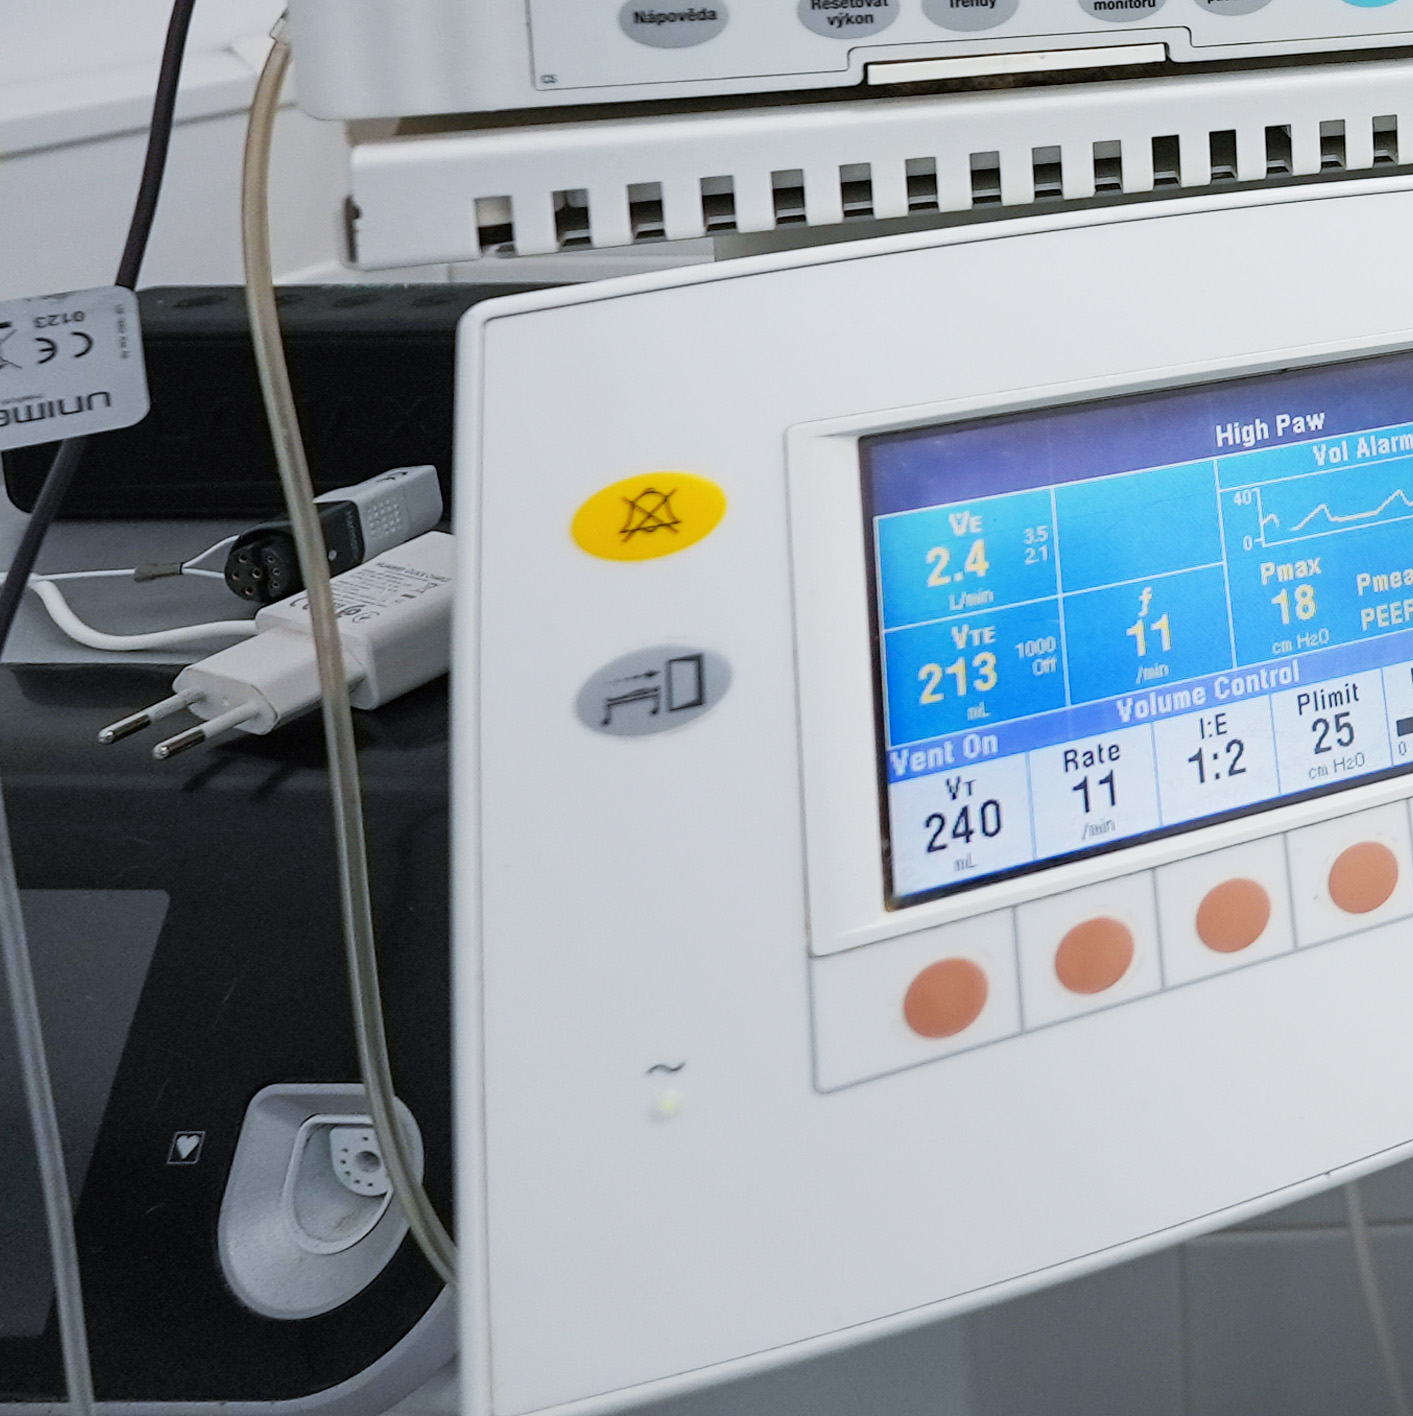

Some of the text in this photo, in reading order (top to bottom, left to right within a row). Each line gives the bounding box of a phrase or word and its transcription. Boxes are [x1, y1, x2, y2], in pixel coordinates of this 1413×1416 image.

[827, 11, 874, 27] výkon
[34, 311, 86, 328] 0123
[1215, 409, 1325, 449] High Paw
[1312, 441, 1350, 469] Vol
[1233, 490, 1254, 509] 40
[926, 538, 990, 588] 2.4
[1260, 553, 1323, 585] Pmax
[1271, 584, 1318, 626] 18
[1126, 611, 1175, 658] 11
[917, 653, 999, 706] 213
[1116, 659, 1301, 724] Volume Control
[1295, 682, 1361, 718] Plimit
[1198, 713, 1230, 740] I:E
[1311, 711, 1356, 756] 25
[891, 731, 999, 779] Vent On
[1063, 739, 1122, 775] Rate
[1186, 737, 1248, 787] 1:2
[1072, 769, 1120, 817] 11
[924, 797, 1004, 856] 240
